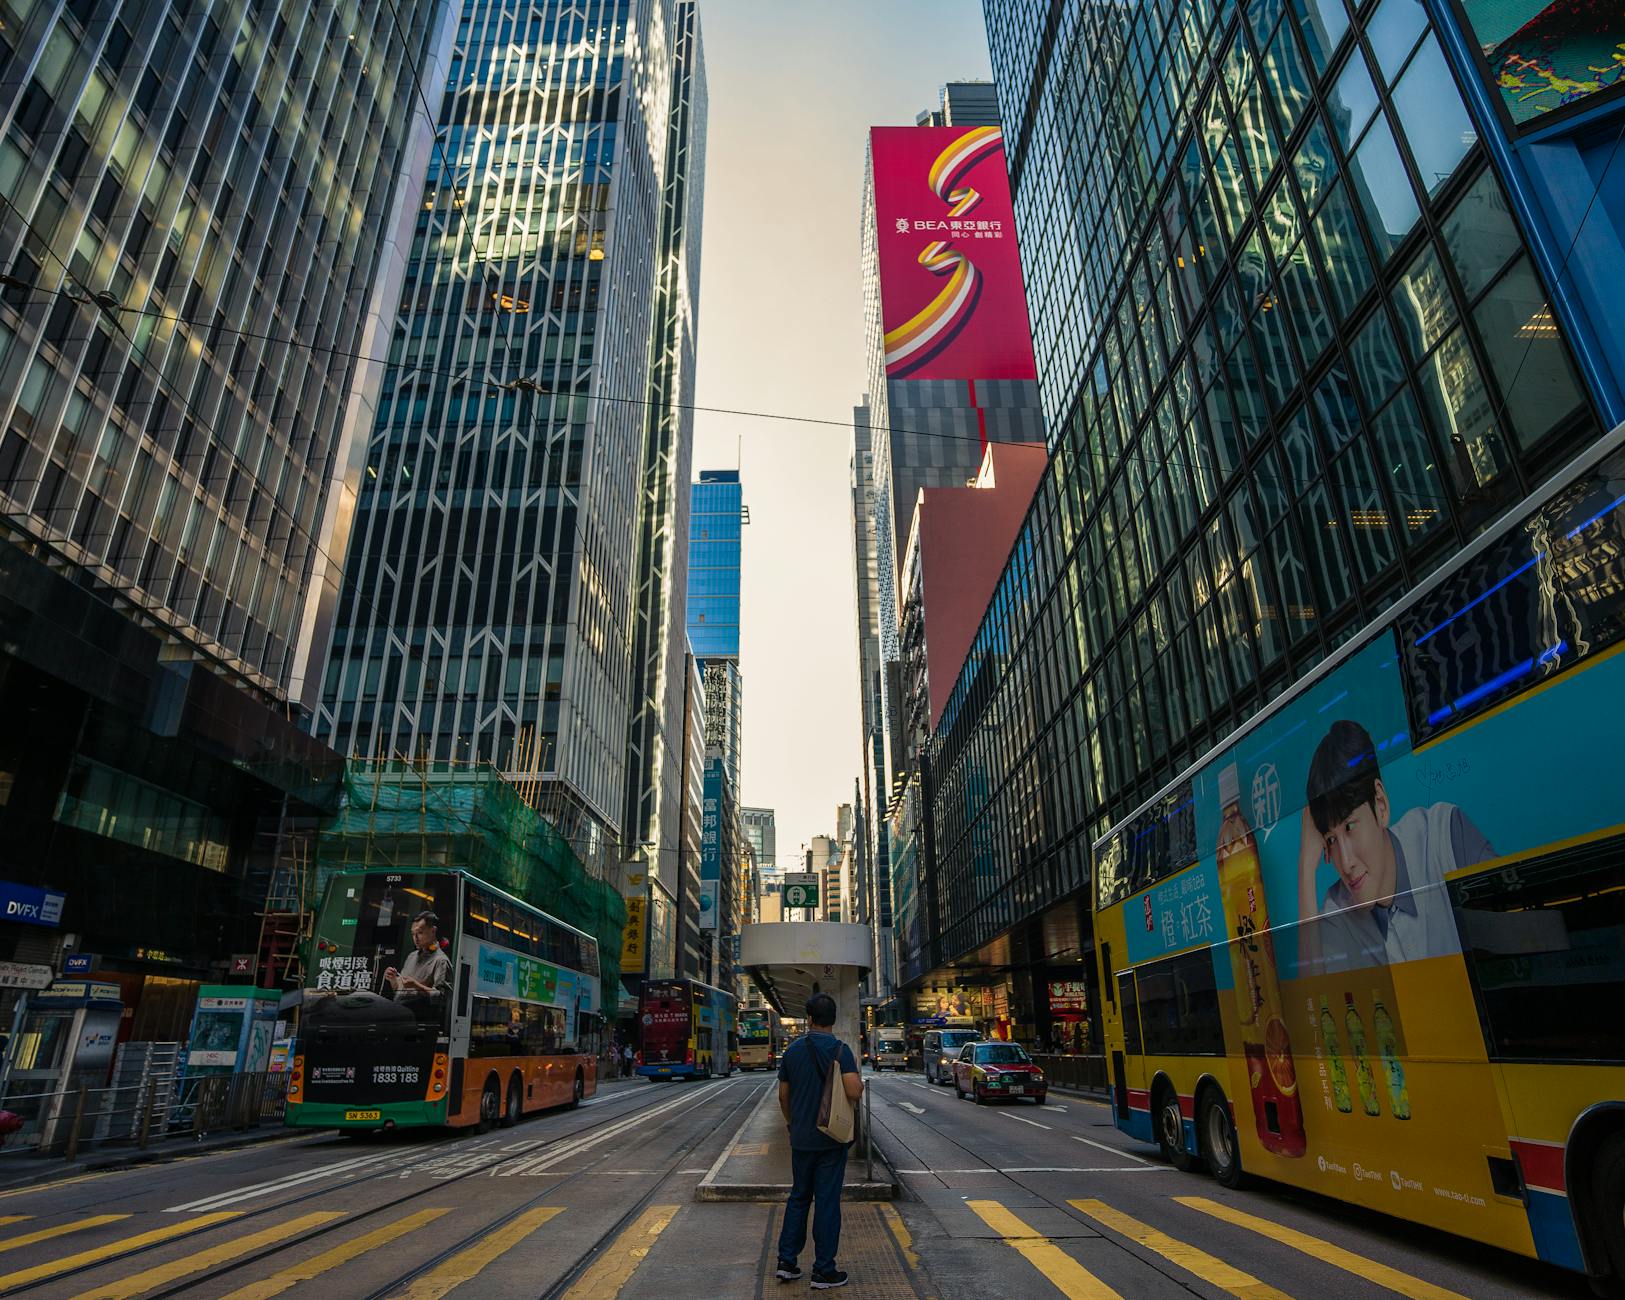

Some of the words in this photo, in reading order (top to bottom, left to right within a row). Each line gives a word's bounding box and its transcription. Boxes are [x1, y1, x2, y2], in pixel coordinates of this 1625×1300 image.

[914, 221, 949, 230] BEA
[950, 220, 1001, 230] 東亞銀行
[1252, 764, 1279, 828] 新
[702, 798, 717, 862] 富邦銀行
[6, 902, 39, 918] DVFX
[68, 959, 88, 967] DVFX
[319, 956, 369, 970] 吸煙引致
[316, 970, 372, 991] 食道癌
[397, 1065, 419, 1073] Quitline
[372, 1073, 397, 1083] 1833
[400, 1073, 419, 1083] 183
